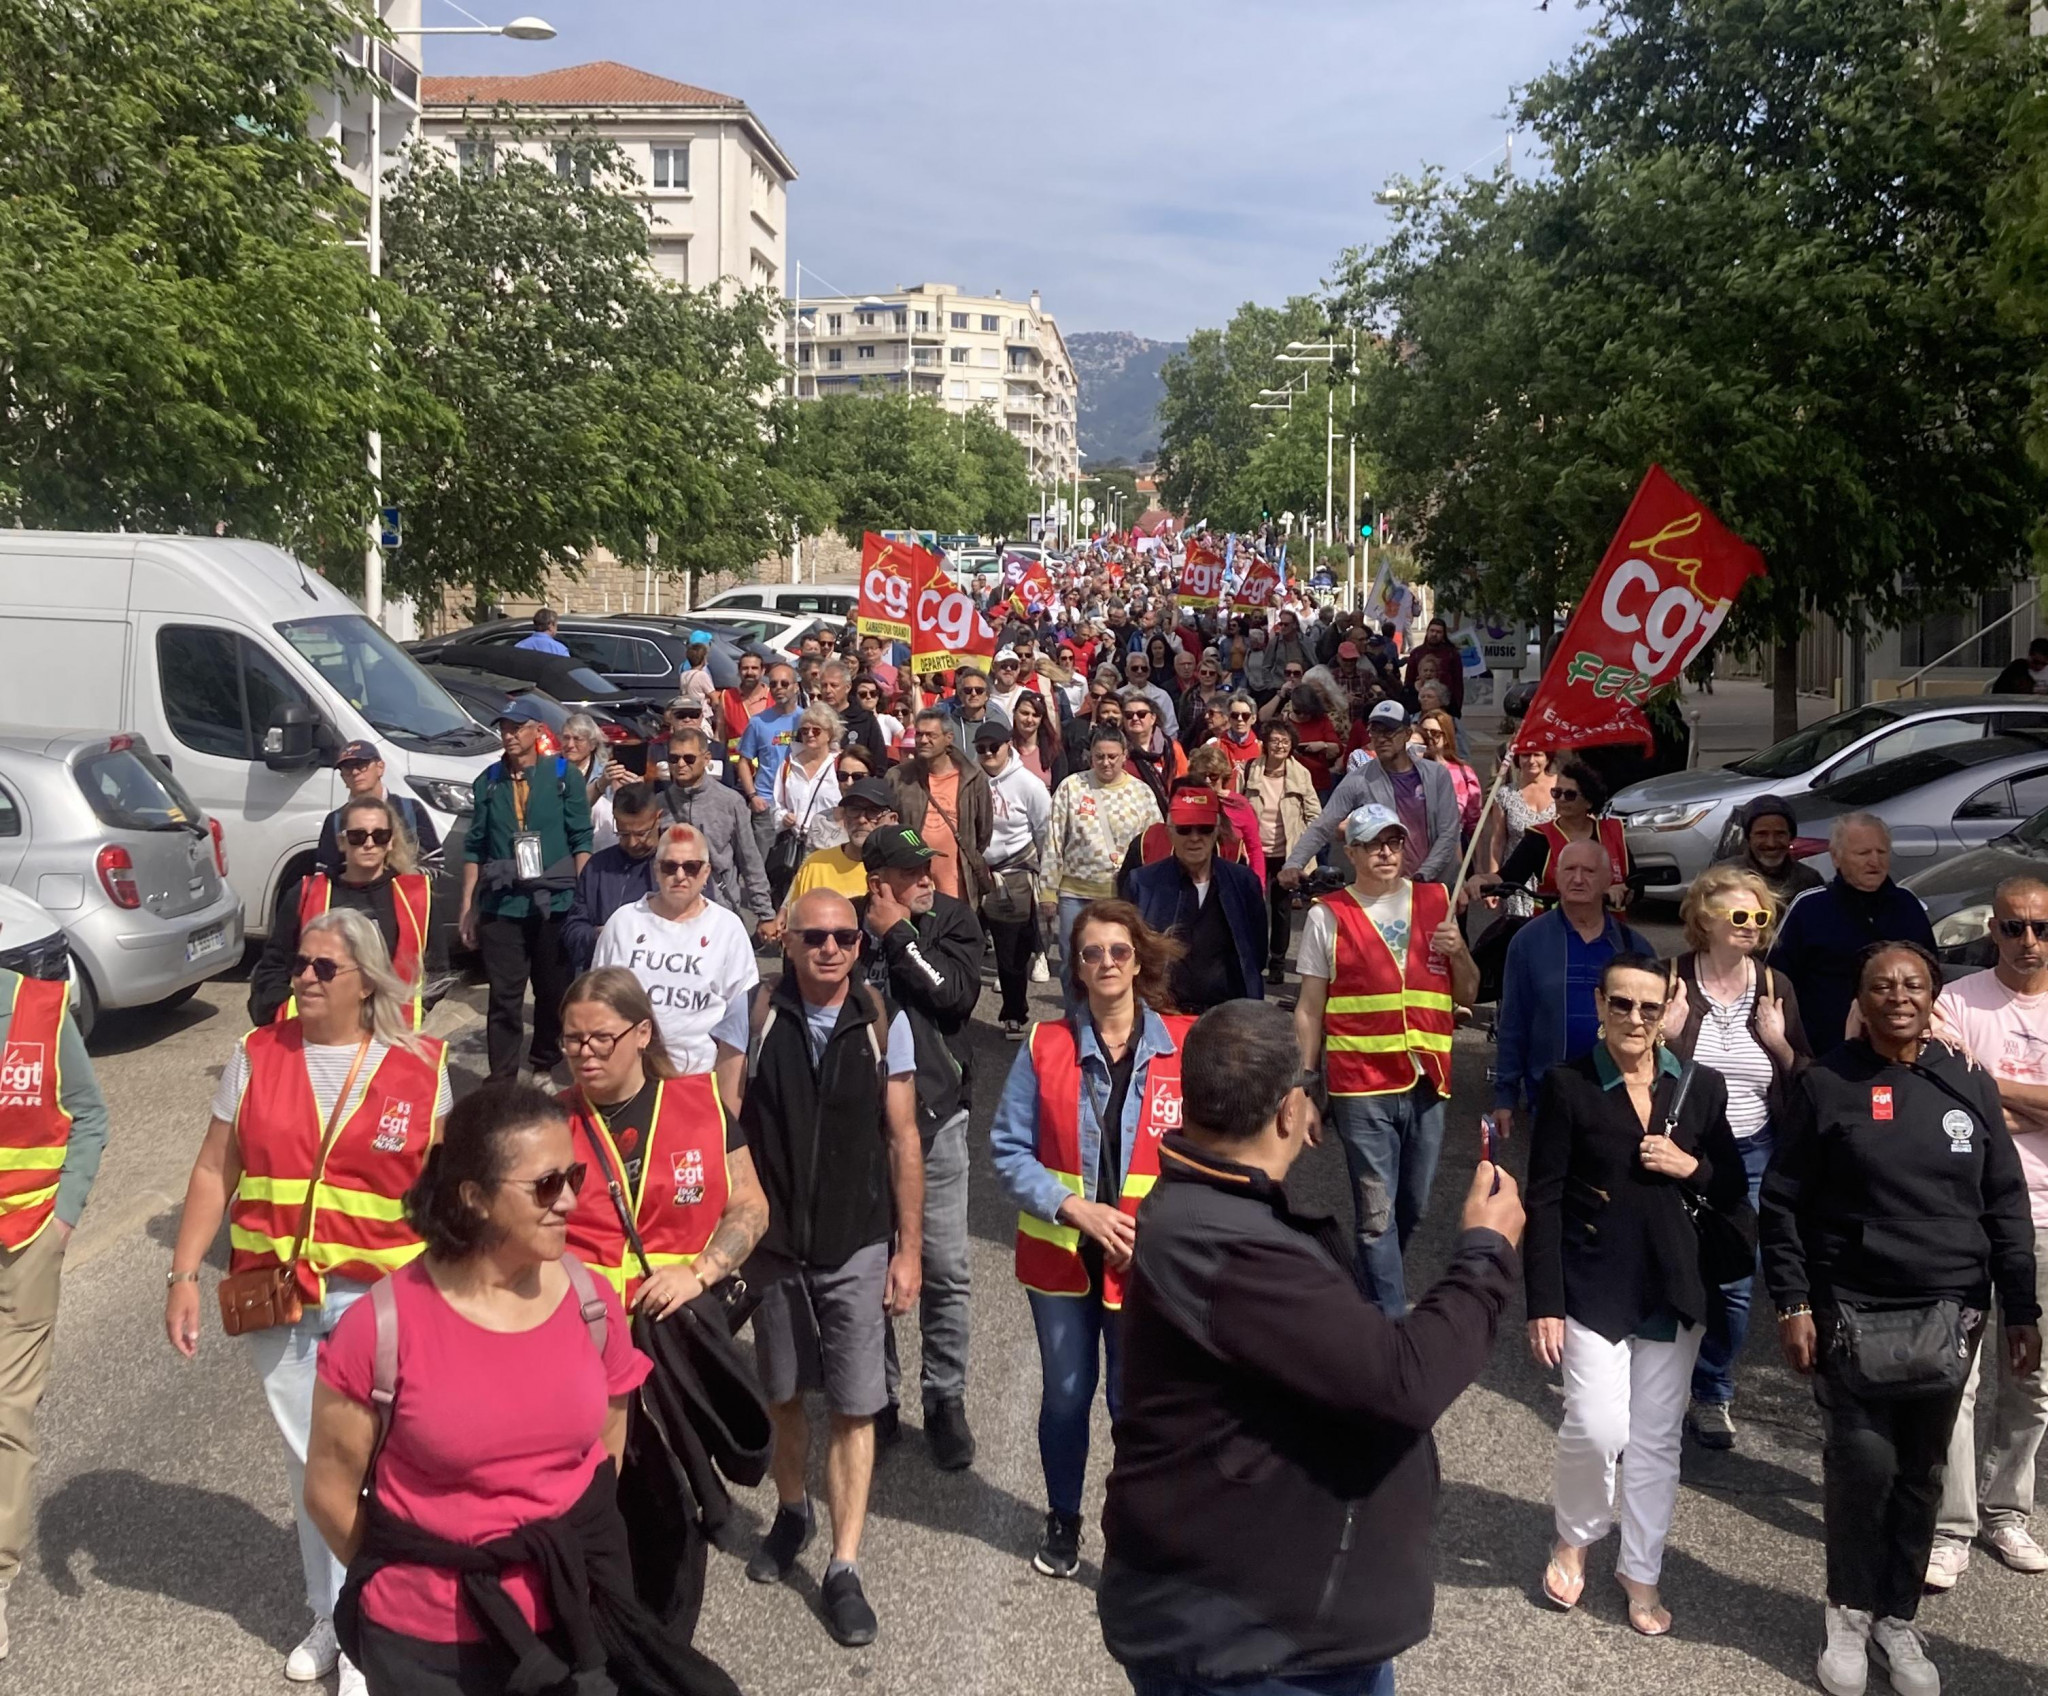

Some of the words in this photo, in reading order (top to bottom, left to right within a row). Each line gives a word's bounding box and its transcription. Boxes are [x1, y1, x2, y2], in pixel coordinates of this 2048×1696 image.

[1184, 561, 1220, 596] cgt
[864, 569, 911, 619] cg
[1602, 559, 1733, 677] cgt
[1484, 645, 1516, 657] MUSIC
[1567, 651, 1668, 706] FER
[628, 949, 703, 976] FUCK
[647, 984, 711, 1011] CISM
[2, 1062, 42, 1091] cgt
[379, 1115, 409, 1135] cgt
[674, 1163, 704, 1185] cgt
